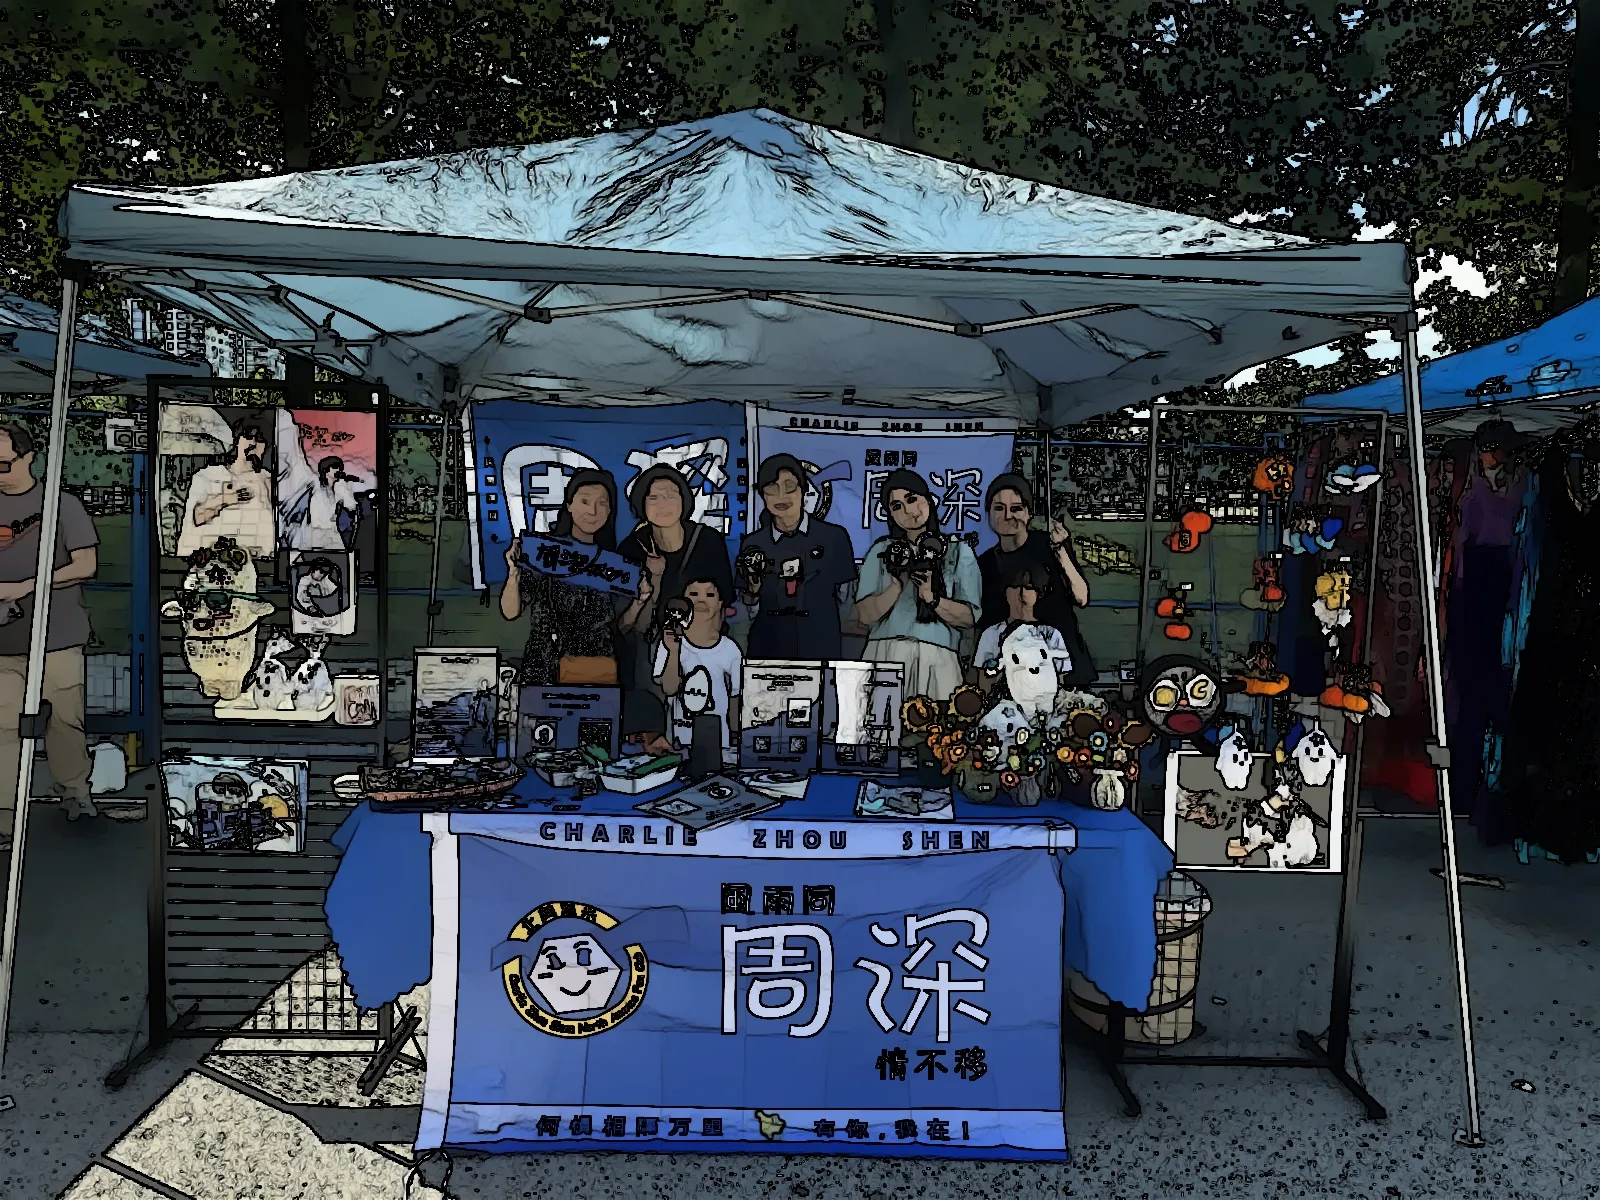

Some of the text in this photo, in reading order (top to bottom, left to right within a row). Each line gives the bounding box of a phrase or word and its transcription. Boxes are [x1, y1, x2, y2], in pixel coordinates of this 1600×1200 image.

[539, 822, 991, 850] CHARLIE ZHOU SHEN
[720, 908, 991, 1043] 周深
[875, 1046, 988, 1081] 情不移
